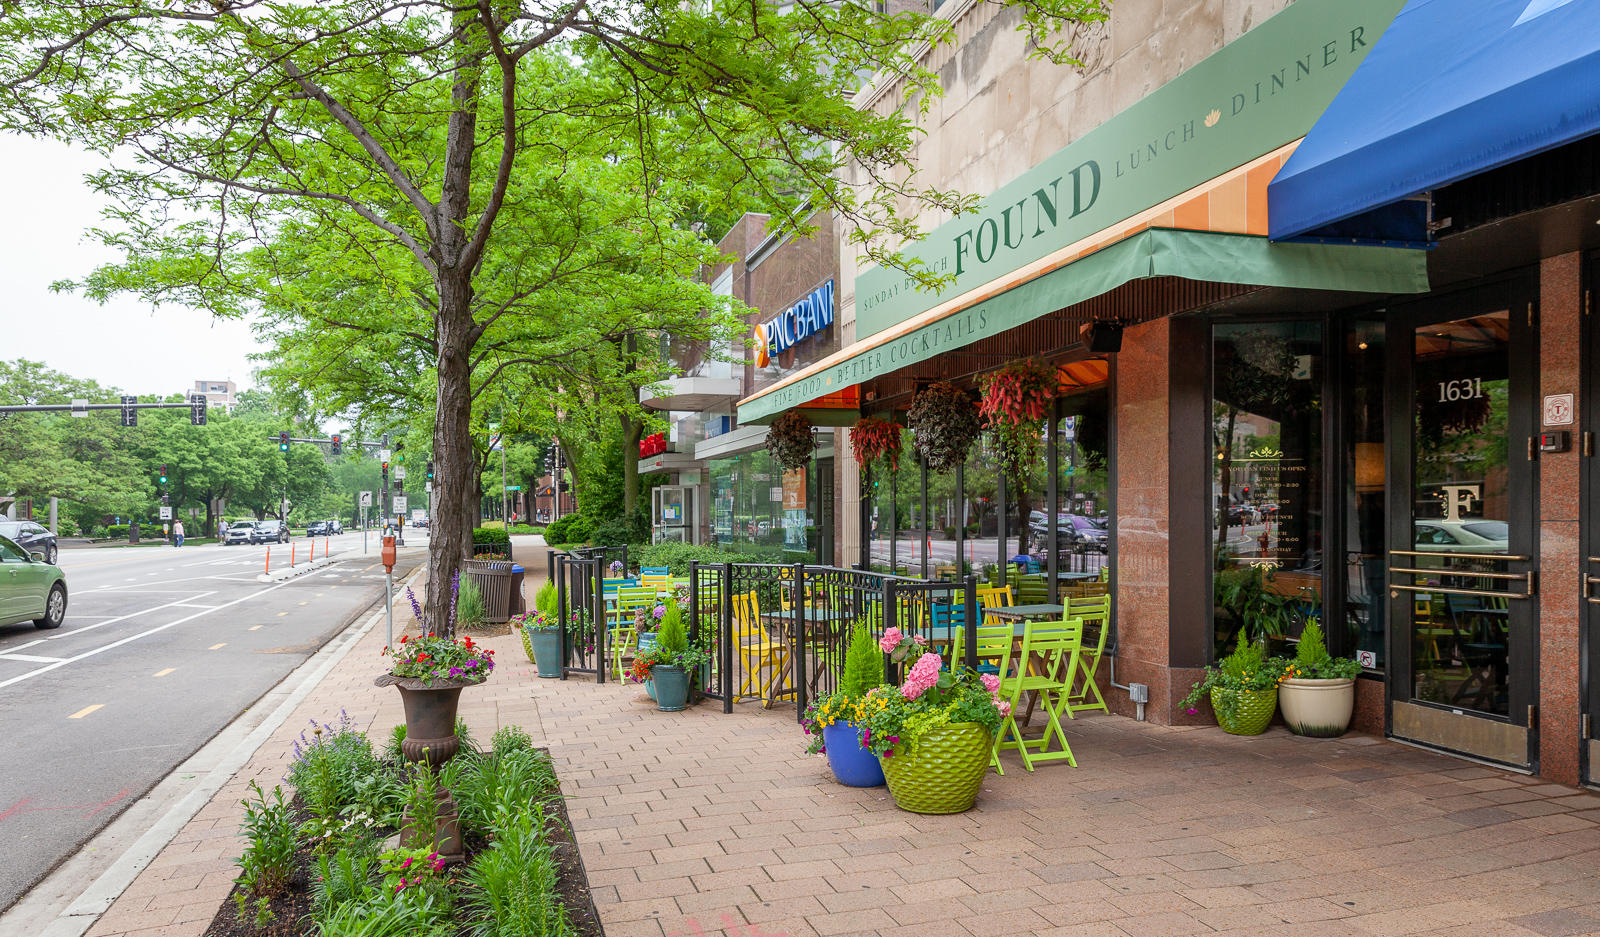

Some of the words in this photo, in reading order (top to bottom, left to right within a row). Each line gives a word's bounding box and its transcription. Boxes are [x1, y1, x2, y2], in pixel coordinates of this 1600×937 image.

[1115, 120, 1195, 178] LUNCH
[1231, 26, 1368, 117] DINNER
[953, 160, 1101, 277] FOUND
[864, 282, 899, 311] SUNDAY
[774, 388, 793, 408] FINE
[796, 377, 821, 399] FOOD
[837, 352, 882, 384] BETTER
[890, 309, 987, 363] COCKTAILS
[1438, 377, 1483, 403] 1631
[1441, 485, 1480, 524] F
